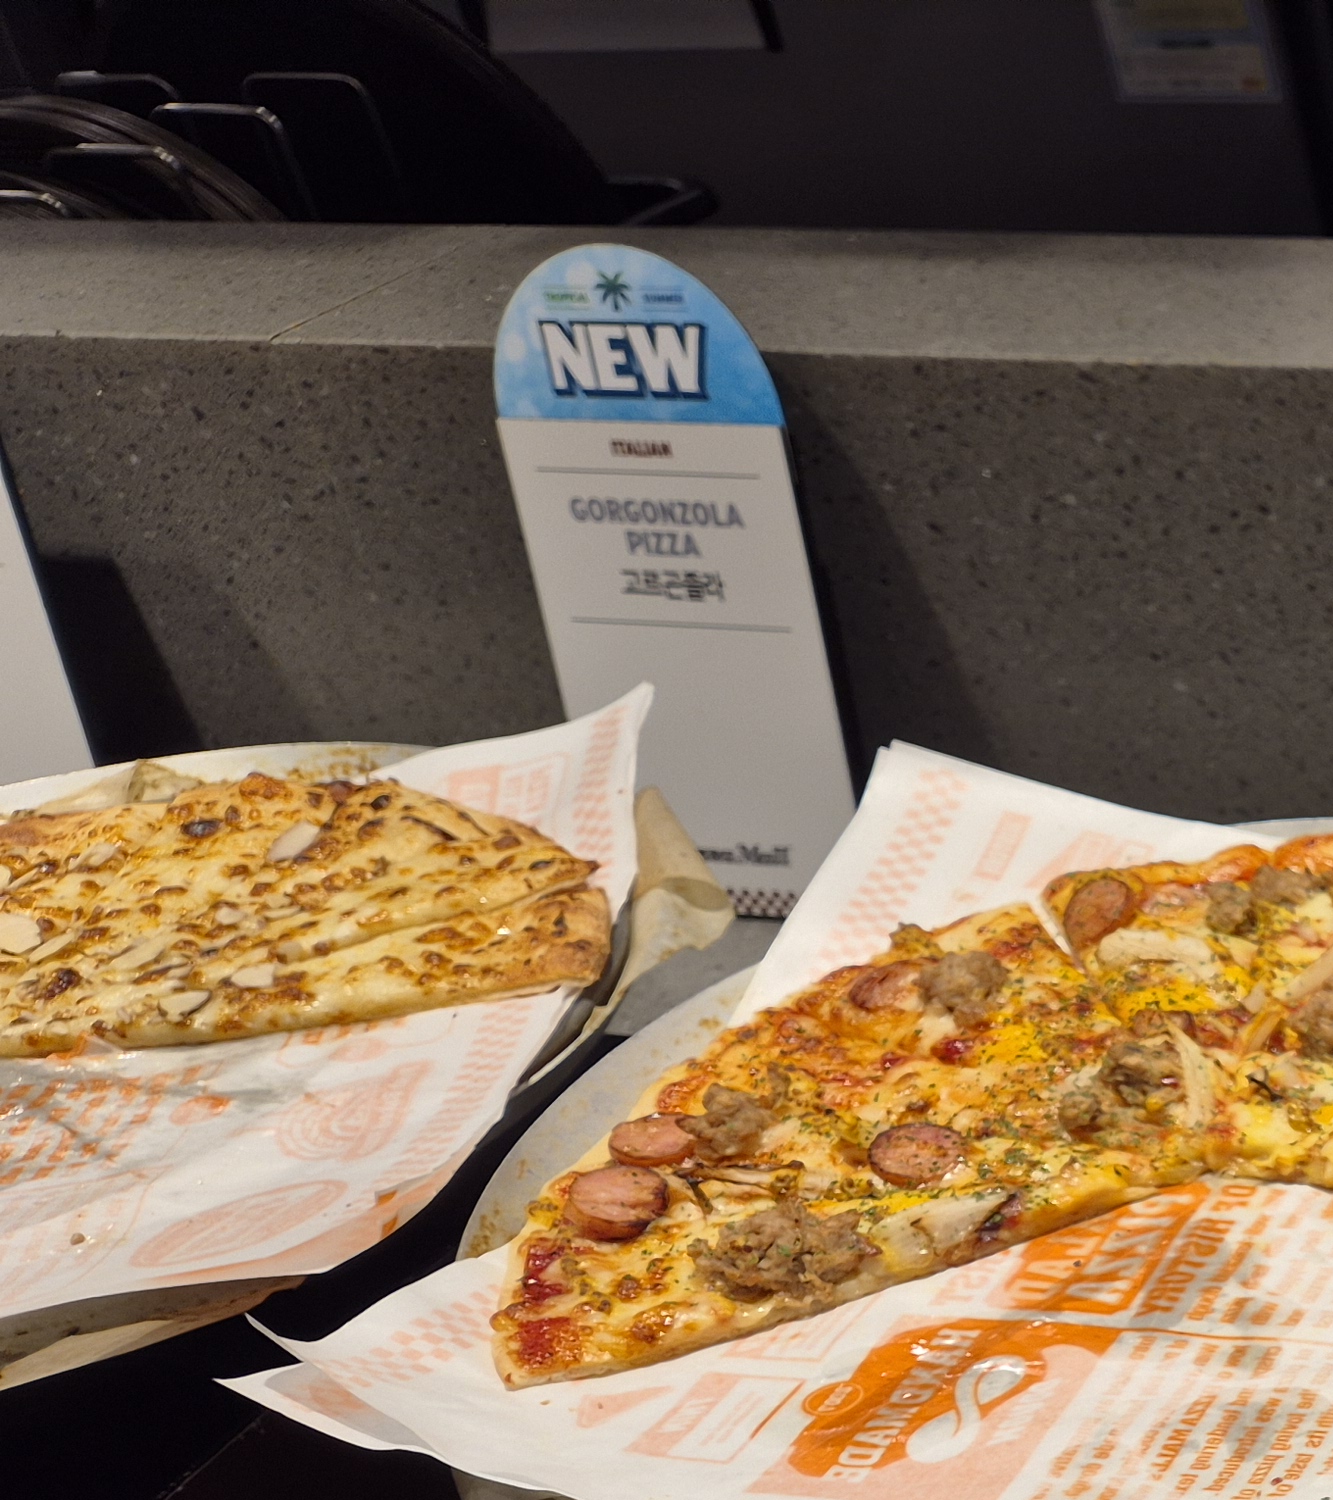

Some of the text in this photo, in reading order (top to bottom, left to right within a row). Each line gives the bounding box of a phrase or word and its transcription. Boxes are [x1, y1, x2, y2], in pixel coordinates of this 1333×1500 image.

[539, 320, 709, 399] NEW
[610, 438, 673, 458] ITALIAN
[569, 496, 745, 528] GORGONZOLA
[625, 530, 702, 558] PIZZA
